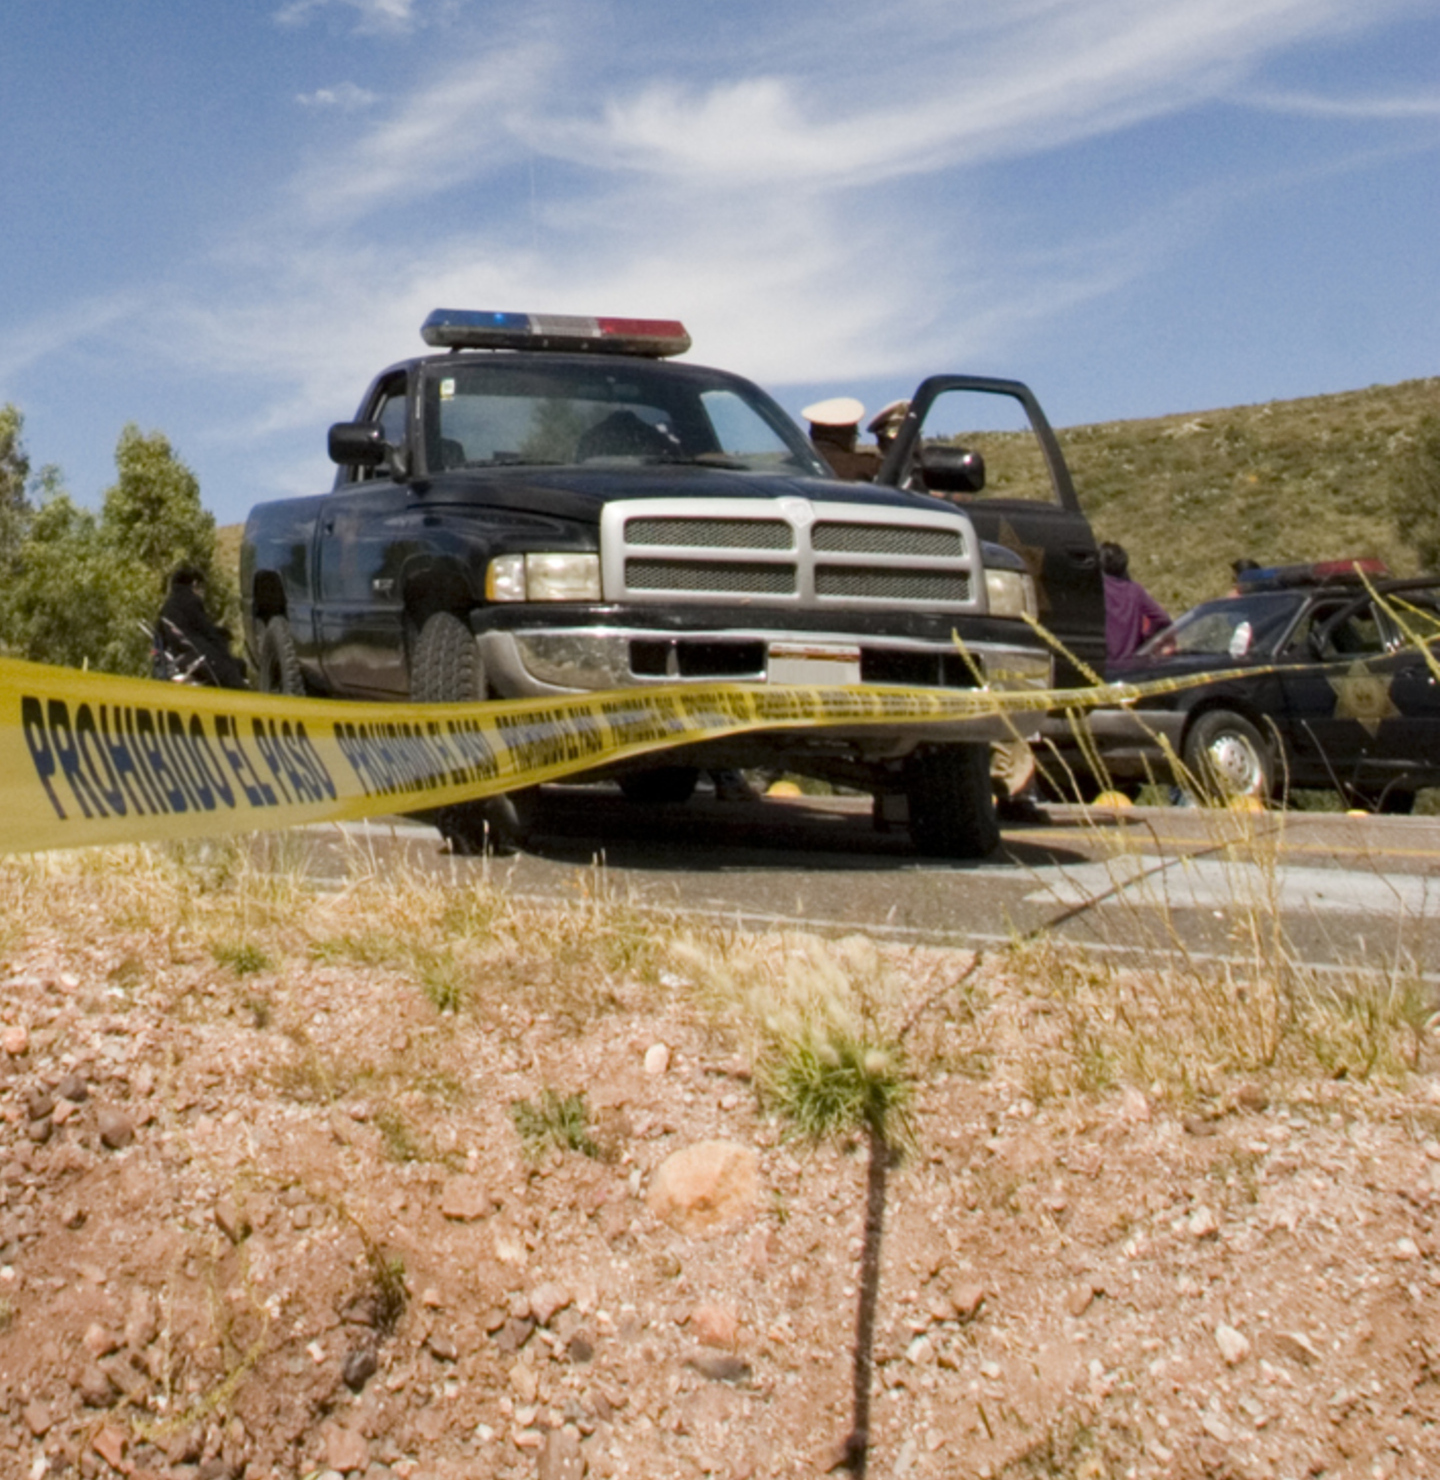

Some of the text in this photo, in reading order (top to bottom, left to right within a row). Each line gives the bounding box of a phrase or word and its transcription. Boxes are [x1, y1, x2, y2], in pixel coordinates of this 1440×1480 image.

[21, 695, 337, 820] PROHIBIDO EL PASO
